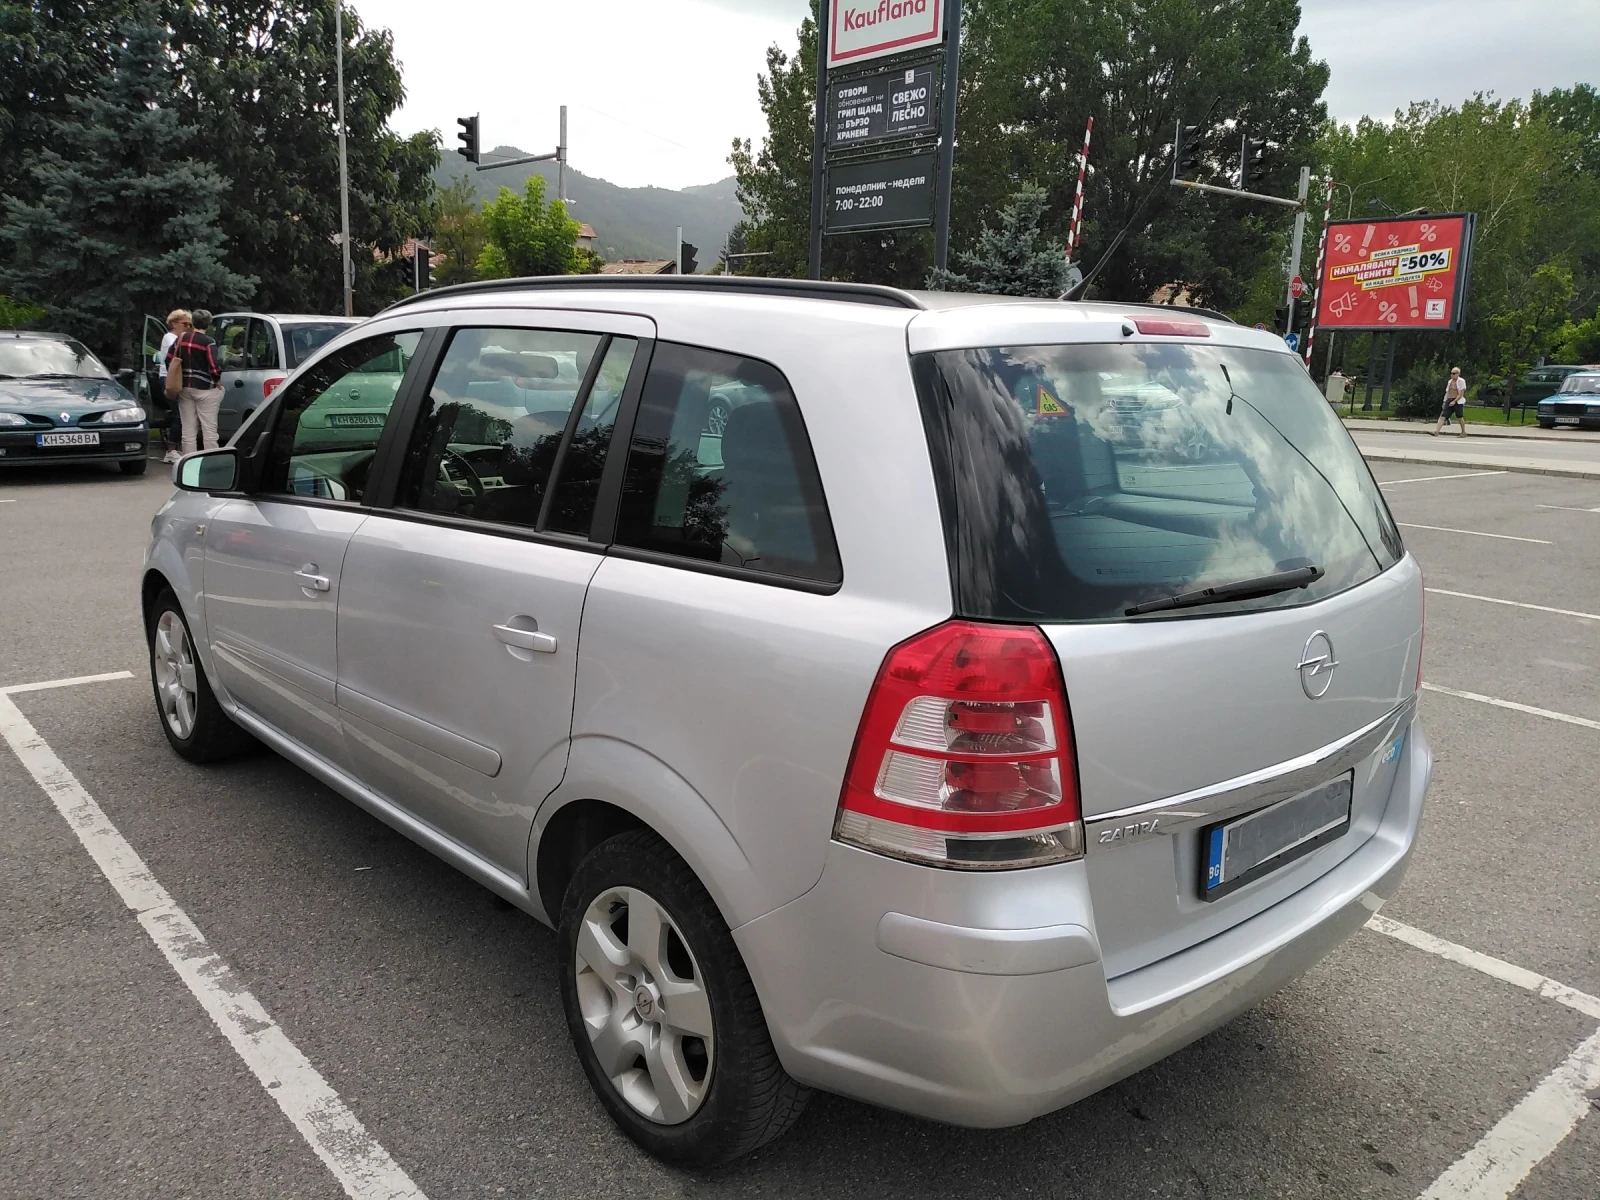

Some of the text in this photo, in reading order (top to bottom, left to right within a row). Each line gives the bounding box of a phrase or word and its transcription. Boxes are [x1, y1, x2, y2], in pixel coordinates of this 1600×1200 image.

[838, 85, 868, 99] ОТВОРИ
[892, 87, 927, 105] СВЕЖО
[837, 95, 875, 108] обновеният
[837, 103, 883, 119] ГРИЛ ЩАНД
[891, 105, 925, 123] ЛЕСНО
[845, 117, 870, 129] БЪРЗО
[836, 128, 869, 141] ХРАНЕНЕ
[1333, 258, 1398, 276] НАМАЛЯВАМЕ
[1402, 251, 1445, 270] -50%
[1356, 268, 1393, 281] ЦЕНИТЕ
[1292, 283, 1302, 291] STOP
[1098, 819, 1160, 844] ZAFIRA
[1209, 864, 1220, 879] BG
